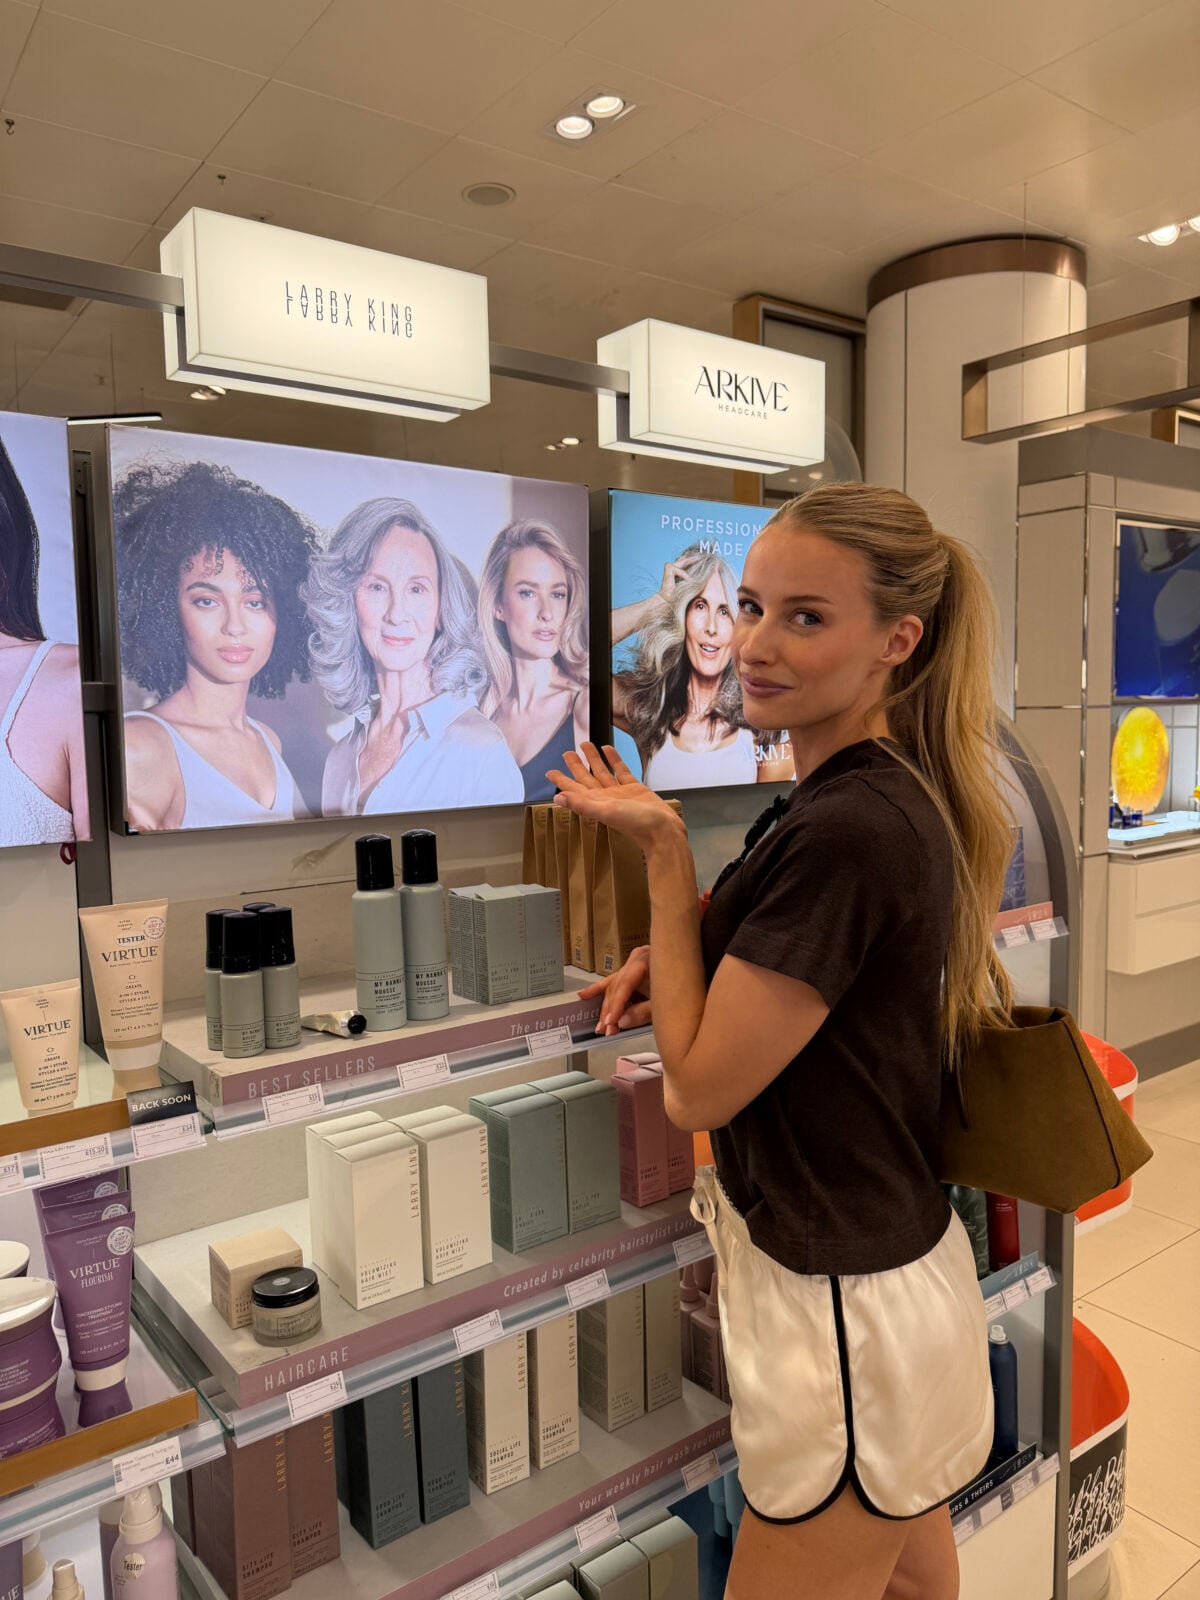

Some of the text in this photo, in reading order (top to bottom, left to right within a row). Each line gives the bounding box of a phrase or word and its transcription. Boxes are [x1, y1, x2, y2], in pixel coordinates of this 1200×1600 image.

[285, 281, 412, 322] LARRY KING
[694, 366, 789, 412] ARKIVE
[718, 404, 768, 420] HEADCARE
[661, 514, 761, 537] PROFESSION
[699, 540, 743, 556] MADE
[117, 934, 146, 944] TESTER
[101, 945, 159, 963] VIRTUE
[24, 1021, 71, 1037] VIRTUE
[511, 1024, 530, 1036] The
[535, 1017, 553, 1029] top
[249, 1055, 376, 1099] BEST SELLERS
[132, 1093, 192, 1113] BACK SOON
[479, 1128, 489, 1196] LARRY KING
[409, 1148, 420, 1219] LARRY KING
[69, 1258, 120, 1280] VIRTUE
[503, 1271, 547, 1297] Created
[552, 1266, 565, 1280] by
[568, 1246, 616, 1272] celebrity
[620, 1226, 672, 1253] hairstylist
[81, 1272, 114, 1289] FLOURISH
[265, 1346, 349, 1392] HAIRCARE
[165, 1454, 179, 1465] £44
[489, 1446, 508, 1458] SOCIAL
[489, 1451, 514, 1465] SHAMPOO
[578, 1492, 602, 1512] Your
[606, 1470, 641, 1498] weekly
[644, 1461, 664, 1477] hair
[667, 1445, 690, 1465] wash
[970, 1479, 994, 1500] THEIRS
[123, 1560, 144, 1572] Tester
